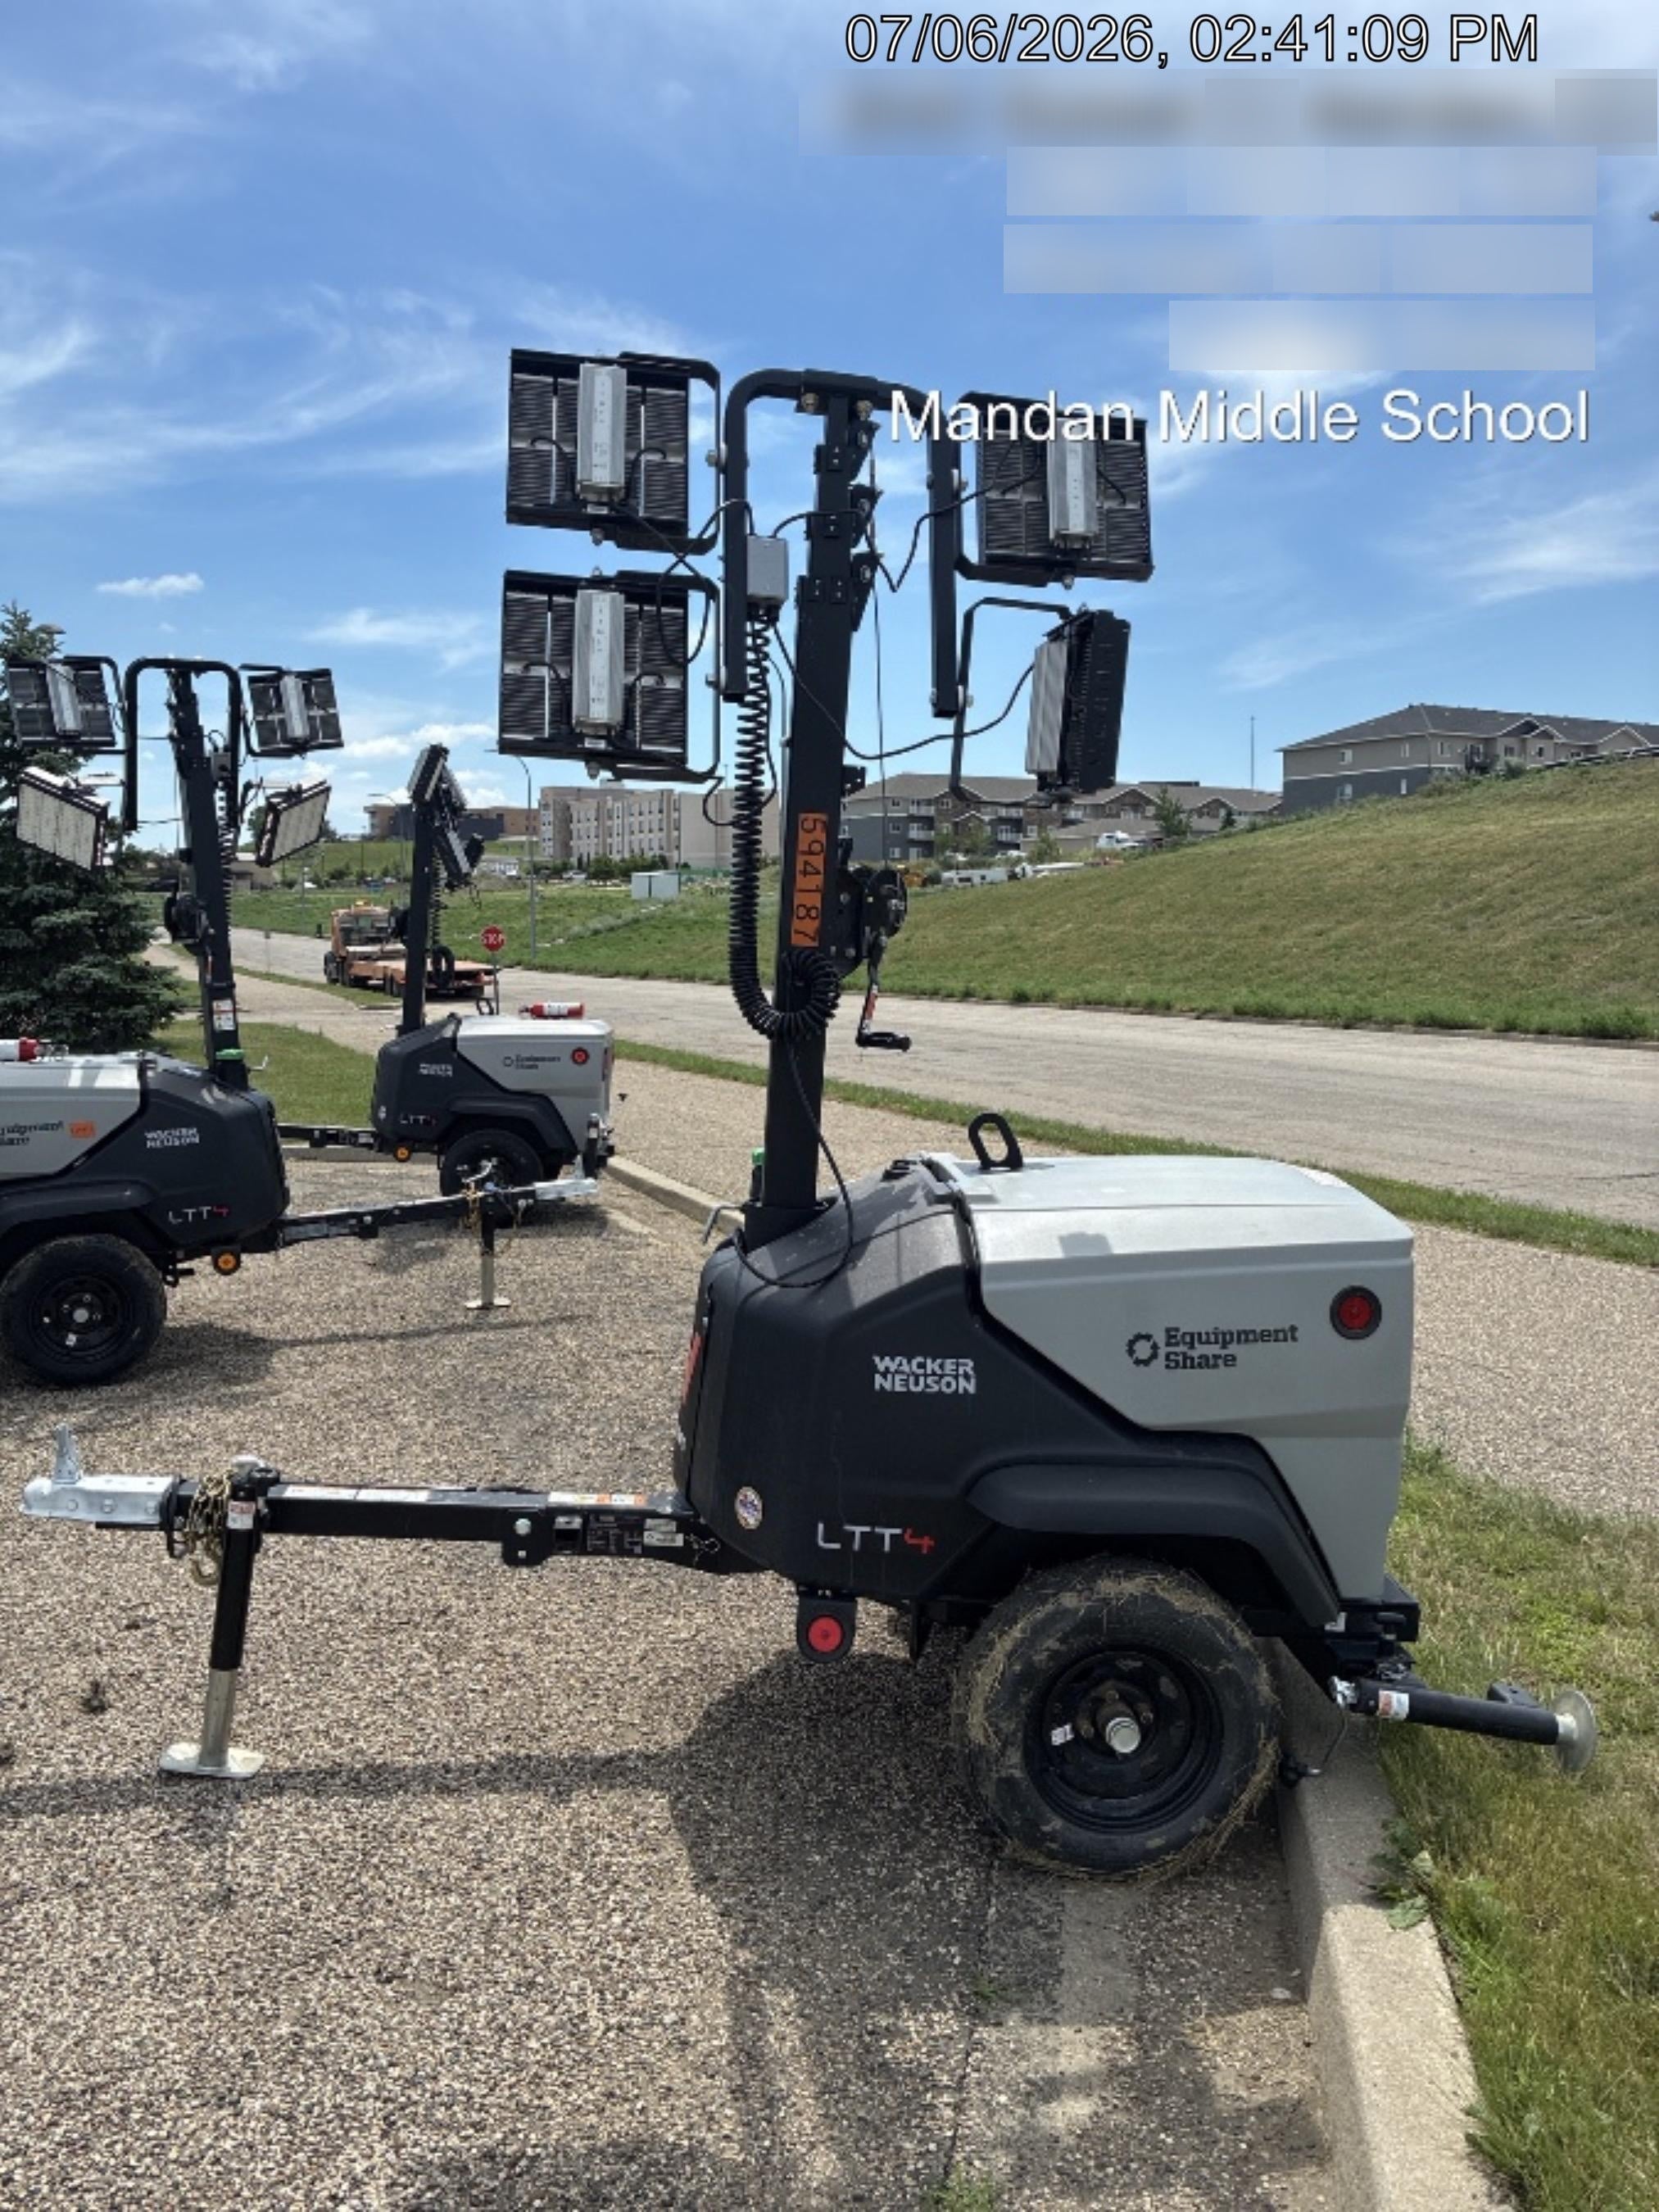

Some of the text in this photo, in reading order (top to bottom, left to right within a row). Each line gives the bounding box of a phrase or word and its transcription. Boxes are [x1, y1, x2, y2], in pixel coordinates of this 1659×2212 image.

[793, 816, 827, 944] 594187
[168, 1204, 229, 1225] LTT4
[1164, 1325, 1299, 1349] Equipment
[873, 1355, 975, 1375] WACKER
[1164, 1351, 1238, 1371] Share
[873, 1373, 977, 1394] NEUSON
[817, 1521, 936, 1555] LTT4
